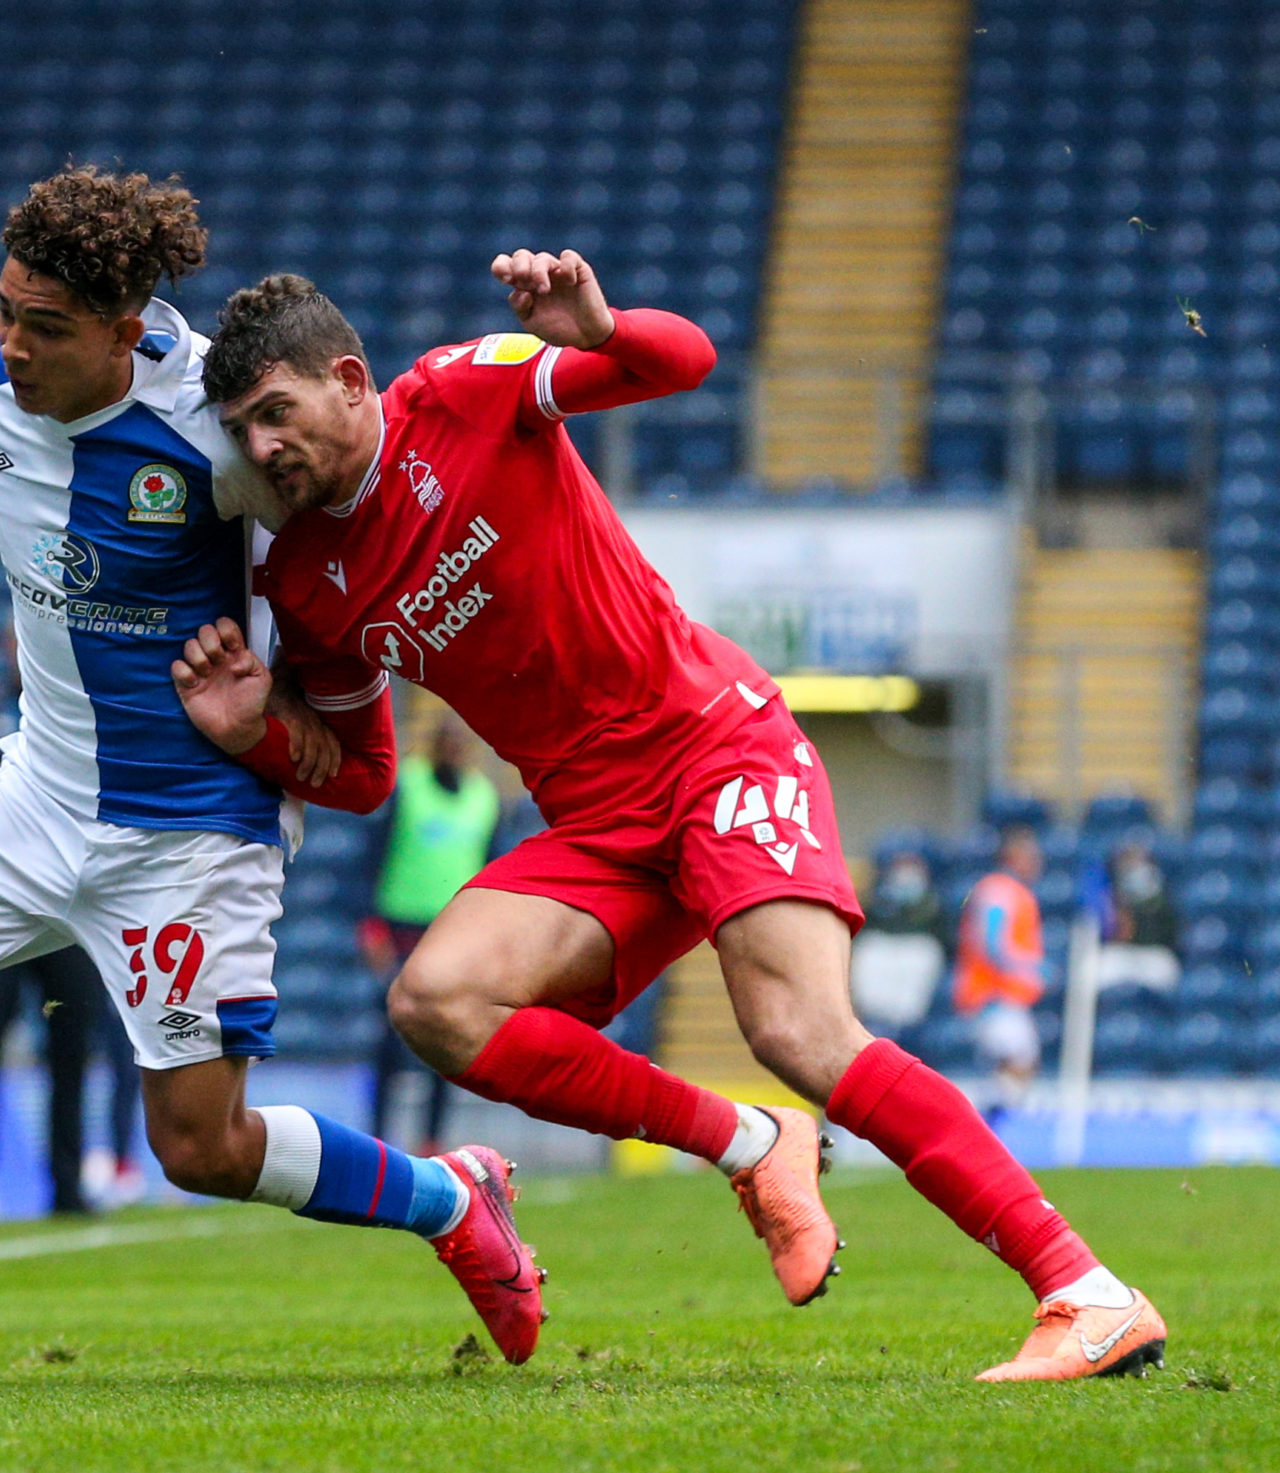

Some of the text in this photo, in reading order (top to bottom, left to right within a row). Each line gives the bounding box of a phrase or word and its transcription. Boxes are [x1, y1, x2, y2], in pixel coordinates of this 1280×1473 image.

[395, 515, 500, 628] Football
[417, 581, 494, 653] Index
[165, 1028, 200, 1041] umbro
